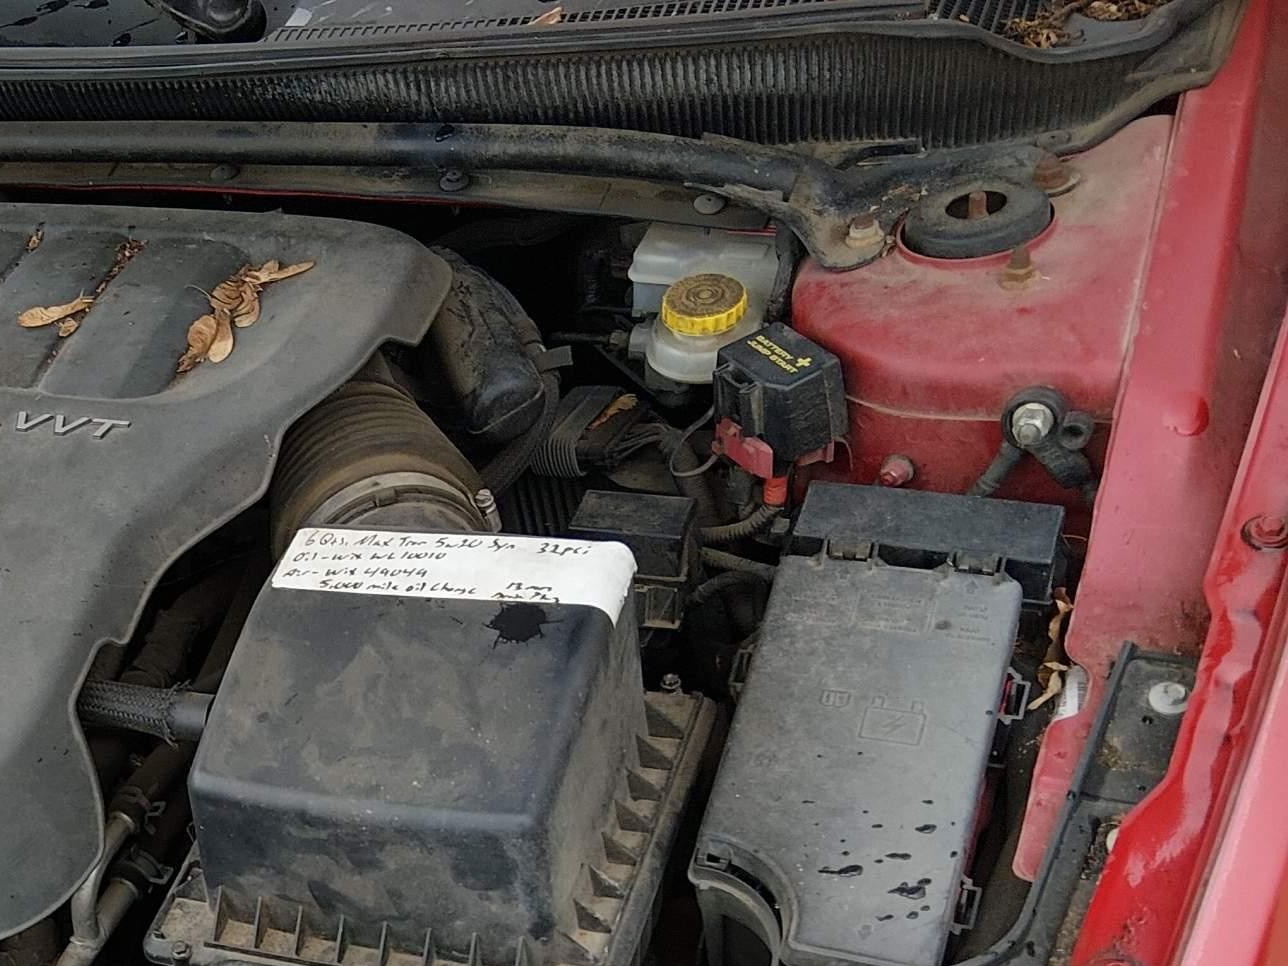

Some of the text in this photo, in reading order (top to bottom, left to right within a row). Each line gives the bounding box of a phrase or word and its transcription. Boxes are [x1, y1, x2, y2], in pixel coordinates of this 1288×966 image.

[755, 335, 794, 360] BATTERY
[16, 410, 132, 440] VVT
[305, 530, 320, 547] 6
